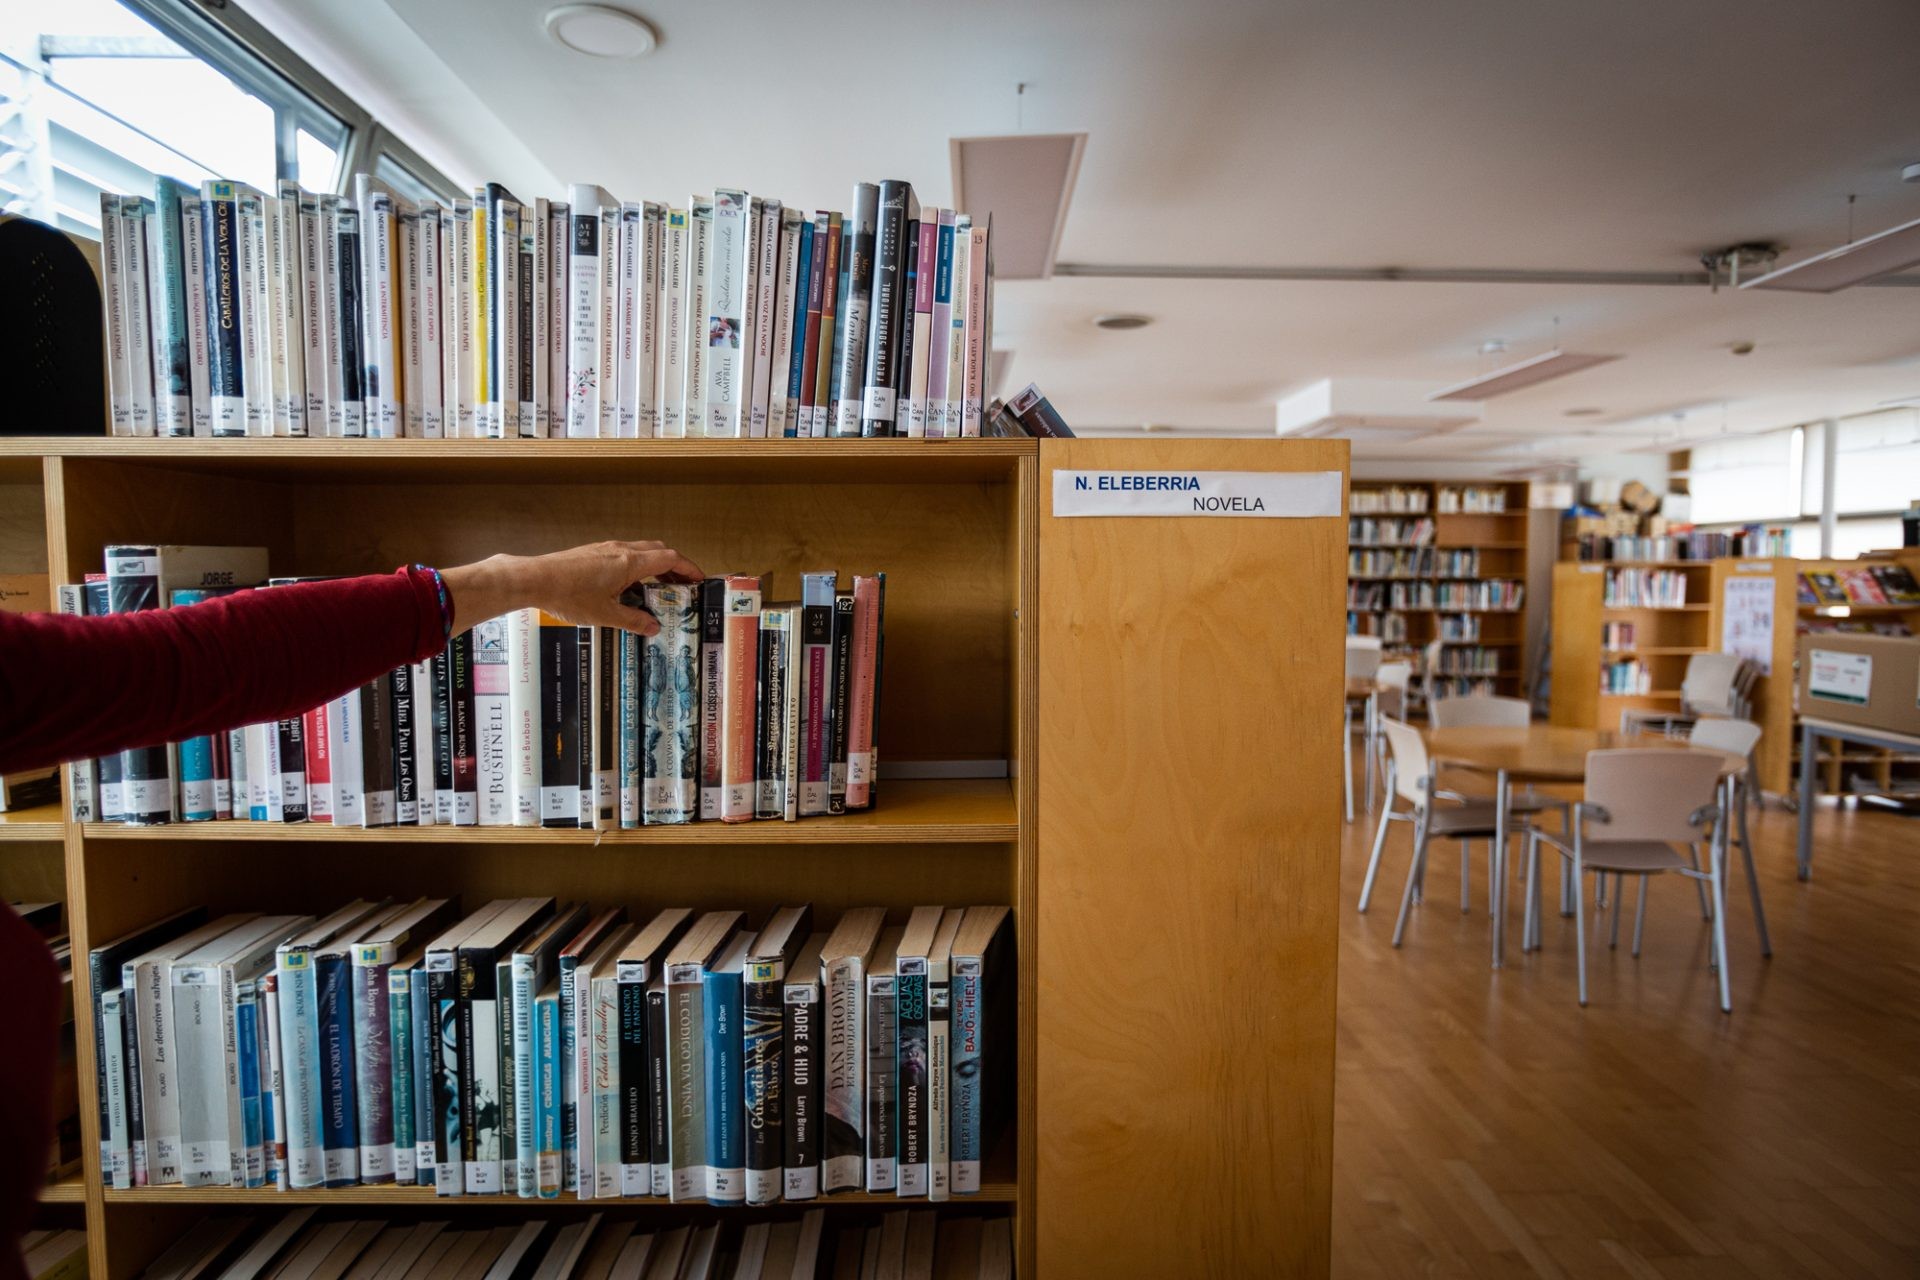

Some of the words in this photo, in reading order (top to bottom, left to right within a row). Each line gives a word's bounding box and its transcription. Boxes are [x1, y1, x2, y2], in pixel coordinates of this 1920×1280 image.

[537, 216, 545, 246] ANDREA
[974, 235, 983, 245] 13
[219, 244, 229, 255] LA
[307, 238, 316, 272] CAMILLERI
[697, 240, 705, 276] CAMILLERI
[309, 280, 316, 289] LA
[309, 290, 317, 308] EDAD
[310, 309, 317, 318] DE
[311, 319, 317, 327] LA
[762, 314, 768, 324] EN
[878, 282, 891, 345] SOBRENATURAL
[695, 340, 701, 349] DE
[693, 351, 701, 399] MONTALBANO
[722, 357, 731, 402] CAMPBELL
[876, 350, 886, 382] FACTOR
[1075, 476, 1092, 491] N.
[1098, 476, 1201, 491] ELEBERRIA
[1193, 497, 1265, 512] NOVELA
[200, 571, 234, 585] JORGE
[838, 600, 853, 612] 127
[455, 643, 463, 652] A
[519, 628, 528, 637] al
[736, 628, 745, 662] CUATRO
[520, 638, 531, 670] opuesto
[626, 630, 635, 668] INVISIBL
[456, 653, 465, 689] MEDIAS
[520, 672, 529, 683] Lo
[707, 650, 718, 680] HUMANA
[736, 663, 745, 681] DEL
[438, 686, 447, 697] LA
[626, 670, 635, 711] CIUDADES
[707, 680, 717, 712] COSECHA
[397, 698, 410, 725] MIEL
[438, 699, 448, 733] NEVADA
[457, 700, 466, 733] BLANCA
[626, 712, 635, 730] LAS
[707, 712, 717, 721] LA
[735, 718, 743, 729] EL
[789, 696, 797, 735] CALVINO
[398, 728, 411, 754] PARA
[440, 734, 448, 750] DEL
[522, 709, 531, 751] Buxbaum
[707, 722, 717, 758] CALDERÓN
[458, 734, 467, 774] BUSQUETS
[481, 726, 491, 772] CANDACE
[489, 702, 505, 794] BUSHNELL
[626, 739, 635, 767] Calvino
[399, 757, 412, 776] LOS
[441, 752, 449, 775] CUCO
[522, 753, 532, 776] Julie
[400, 777, 413, 801] OSOS
[284, 805, 305, 813] SGEL
[151, 965, 162, 1000] salvajes
[224, 969, 234, 1012] telefónicas
[561, 967, 574, 1027] BRADBURY
[900, 975, 913, 1020] AGUAS
[913, 974, 924, 1020] OSCURAS
[329, 992, 337, 1015] BOYNE
[367, 988, 380, 1018] Boyne
[623, 989, 632, 1029] SILENCIO
[632, 985, 641, 1026] PANTANO
[679, 992, 689, 1006] EL
[718, 1004, 726, 1022] Brown
[152, 1002, 163, 1045] detectives
[329, 1023, 338, 1033] EL
[595, 999, 616, 1051] Bradley
[718, 1023, 727, 1034] Dee
[793, 1001, 809, 1041] PADRE
[957, 1018, 963, 1028] TE
[968, 1010, 975, 1019] EL
[226, 1015, 236, 1053] Llamadas
[562, 1030, 574, 1056] Ray
[624, 1031, 632, 1040] EL
[633, 1027, 642, 1044] DEL
[679, 1008, 692, 1060] CÓDIGO
[965, 1020, 975, 1053] BAJO
[155, 1047, 165, 1063] Los
[329, 1037, 342, 1077] LADRÓN
[794, 1045, 808, 1055] &
[331, 1079, 341, 1091] DE
[541, 1063, 552, 1108] CRÓNICAS
[597, 1052, 609, 1089] Celeste
[680, 1063, 691, 1081] DA
[751, 1038, 765, 1129] Guardianes
[794, 1058, 808, 1085] HIJO
[830, 1050, 845, 1091] DAN
[332, 1094, 343, 1129] TIEMPO
[599, 1094, 609, 1134] Perdición
[630, 1087, 638, 1123] BRAULIO
[681, 1084, 692, 1118] VINCI
[796, 1095, 807, 1117] Larry
[907, 1085, 917, 1126] BRYNDZA
[961, 1083, 971, 1120] BRYNDZA
[630, 1124, 640, 1156] JUANJO
[797, 1117, 807, 1143] Brown
[798, 1153, 805, 1165] 7
[908, 1128, 918, 1163] ROBERT
